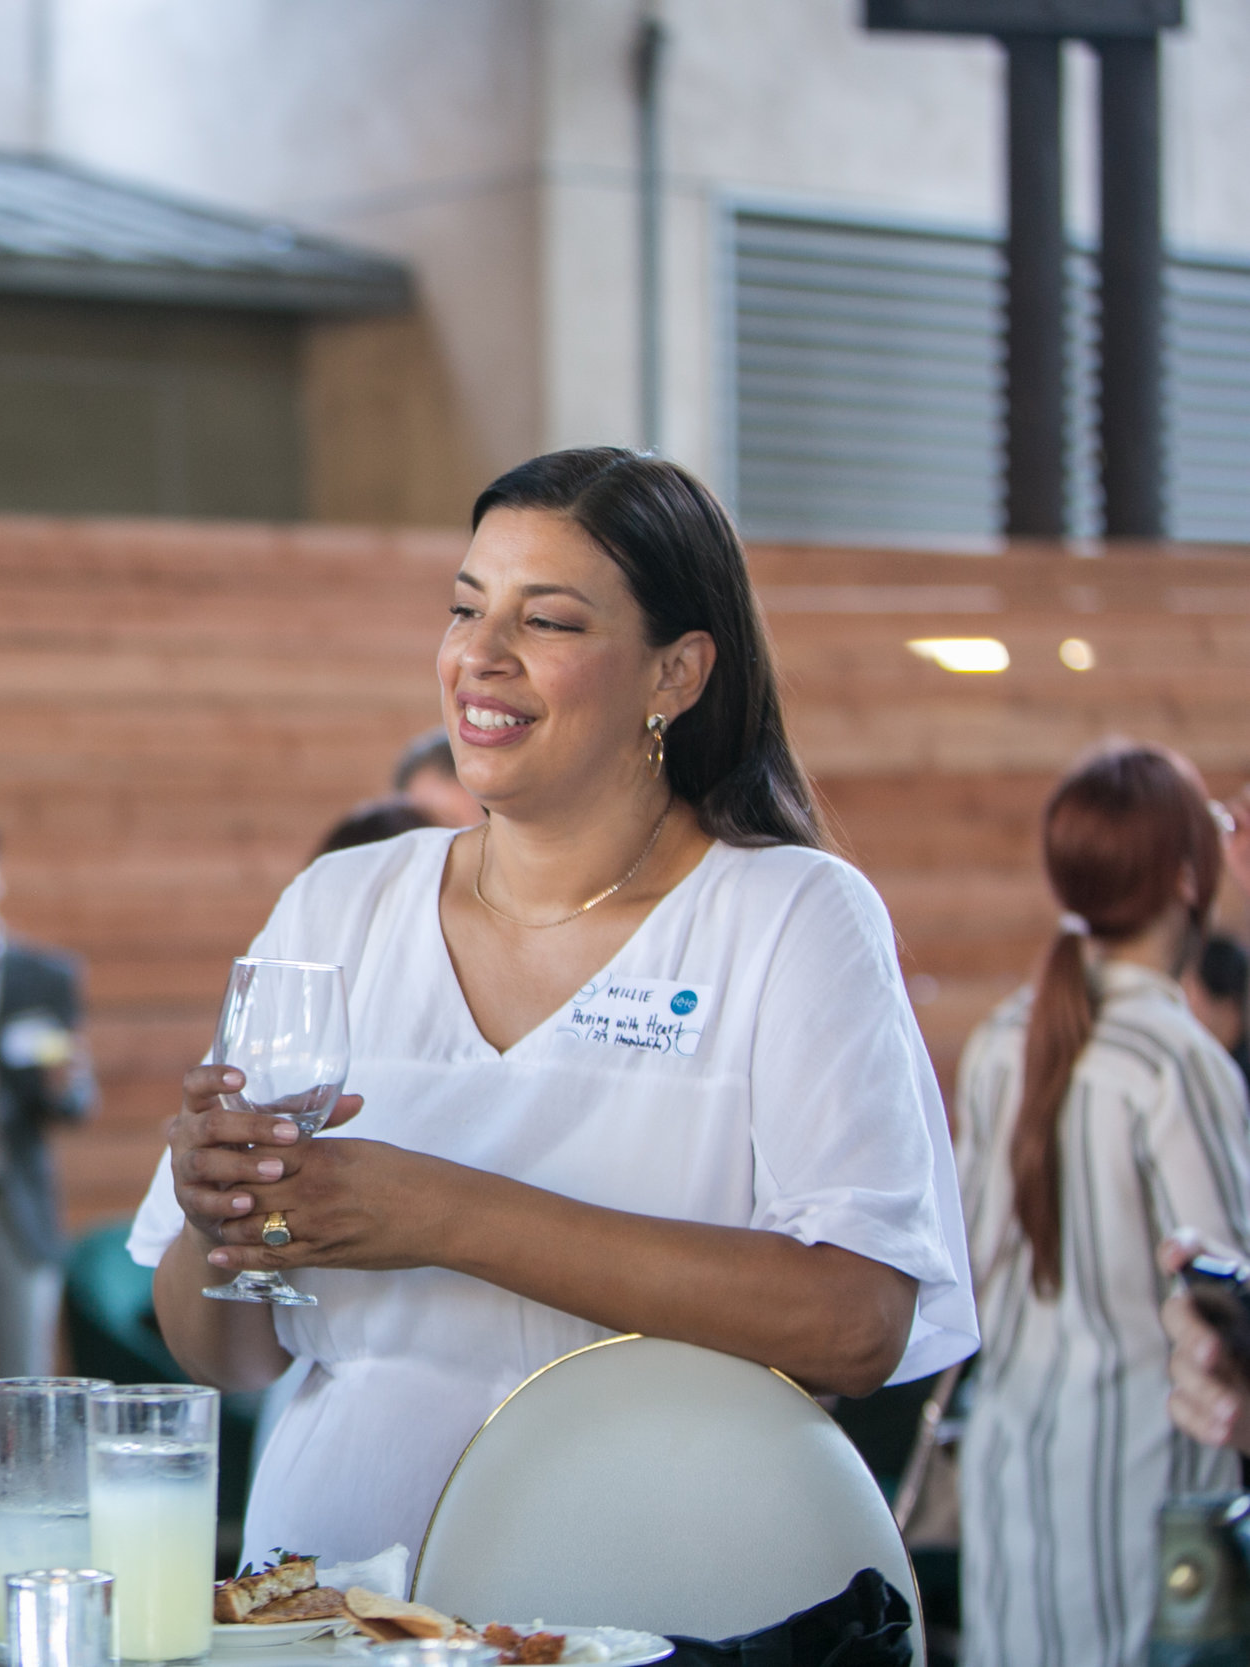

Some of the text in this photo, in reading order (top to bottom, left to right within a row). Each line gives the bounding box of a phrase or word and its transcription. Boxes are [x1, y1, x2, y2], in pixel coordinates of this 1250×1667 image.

[607, 986, 654, 1003] MILLIE
[616, 1016, 639, 1031] with
[646, 1013, 686, 1040] Heart
